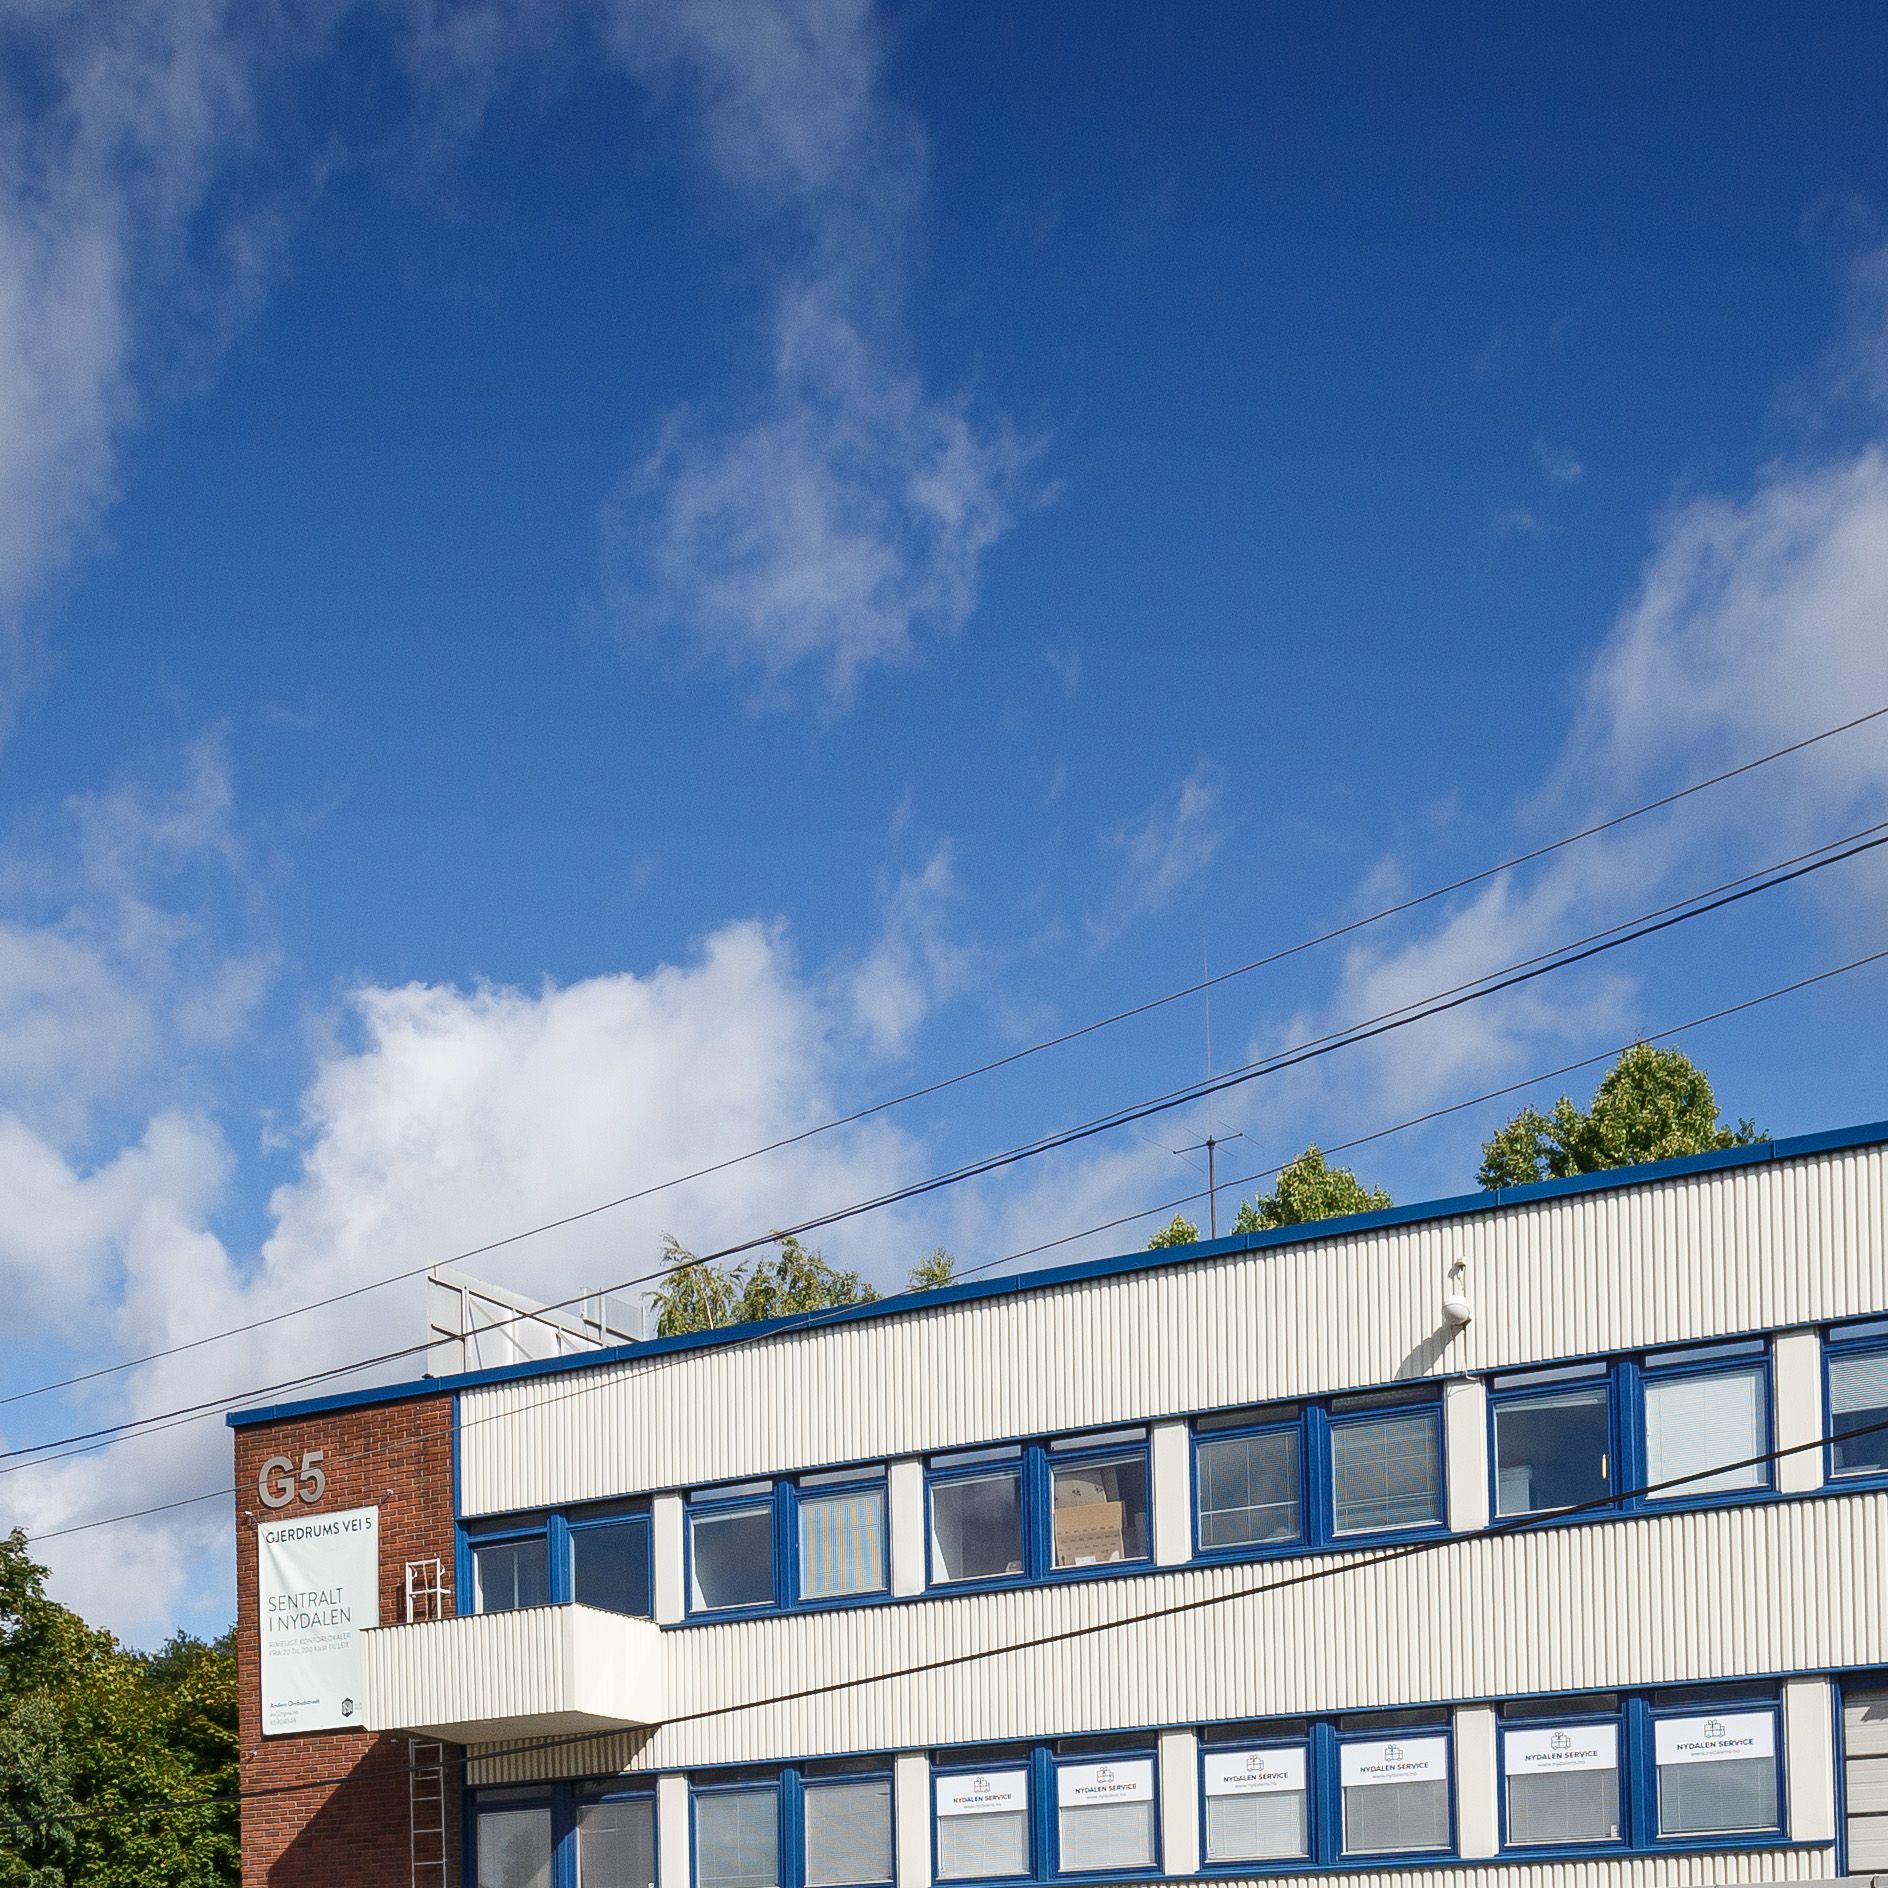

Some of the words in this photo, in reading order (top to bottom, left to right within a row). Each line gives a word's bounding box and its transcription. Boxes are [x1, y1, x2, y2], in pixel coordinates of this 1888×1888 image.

[258, 1450, 326, 1508] G5
[265, 1521, 340, 1544] GJERDRUMS
[342, 1518, 362, 1532] VEI
[365, 1517, 372, 1529] 5
[268, 1587, 343, 1612] SENTRALT
[269, 1617, 273, 1632] I
[278, 1607, 351, 1632] NYDALEN
[1676, 1740, 1716, 1750] NYDALEN
[1718, 1738, 1754, 1747] SERVICE
[1525, 1752, 1562, 1761] NYDALEN
[1564, 1750, 1598, 1759] SERVICE
[1360, 1764, 1395, 1773] NYDALEN
[1397, 1761, 1429, 1770] SERVICE
[1223, 1774, 1257, 1783] NYDALEN
[1258, 1771, 1289, 1780] SERVICE
[1075, 1786, 1107, 1794] NYDALEN
[1108, 1783, 1136, 1791] SERVICE
[953, 1795, 983, 1804] NYDALEN
[984, 1793, 1011, 1801] SERVICE
